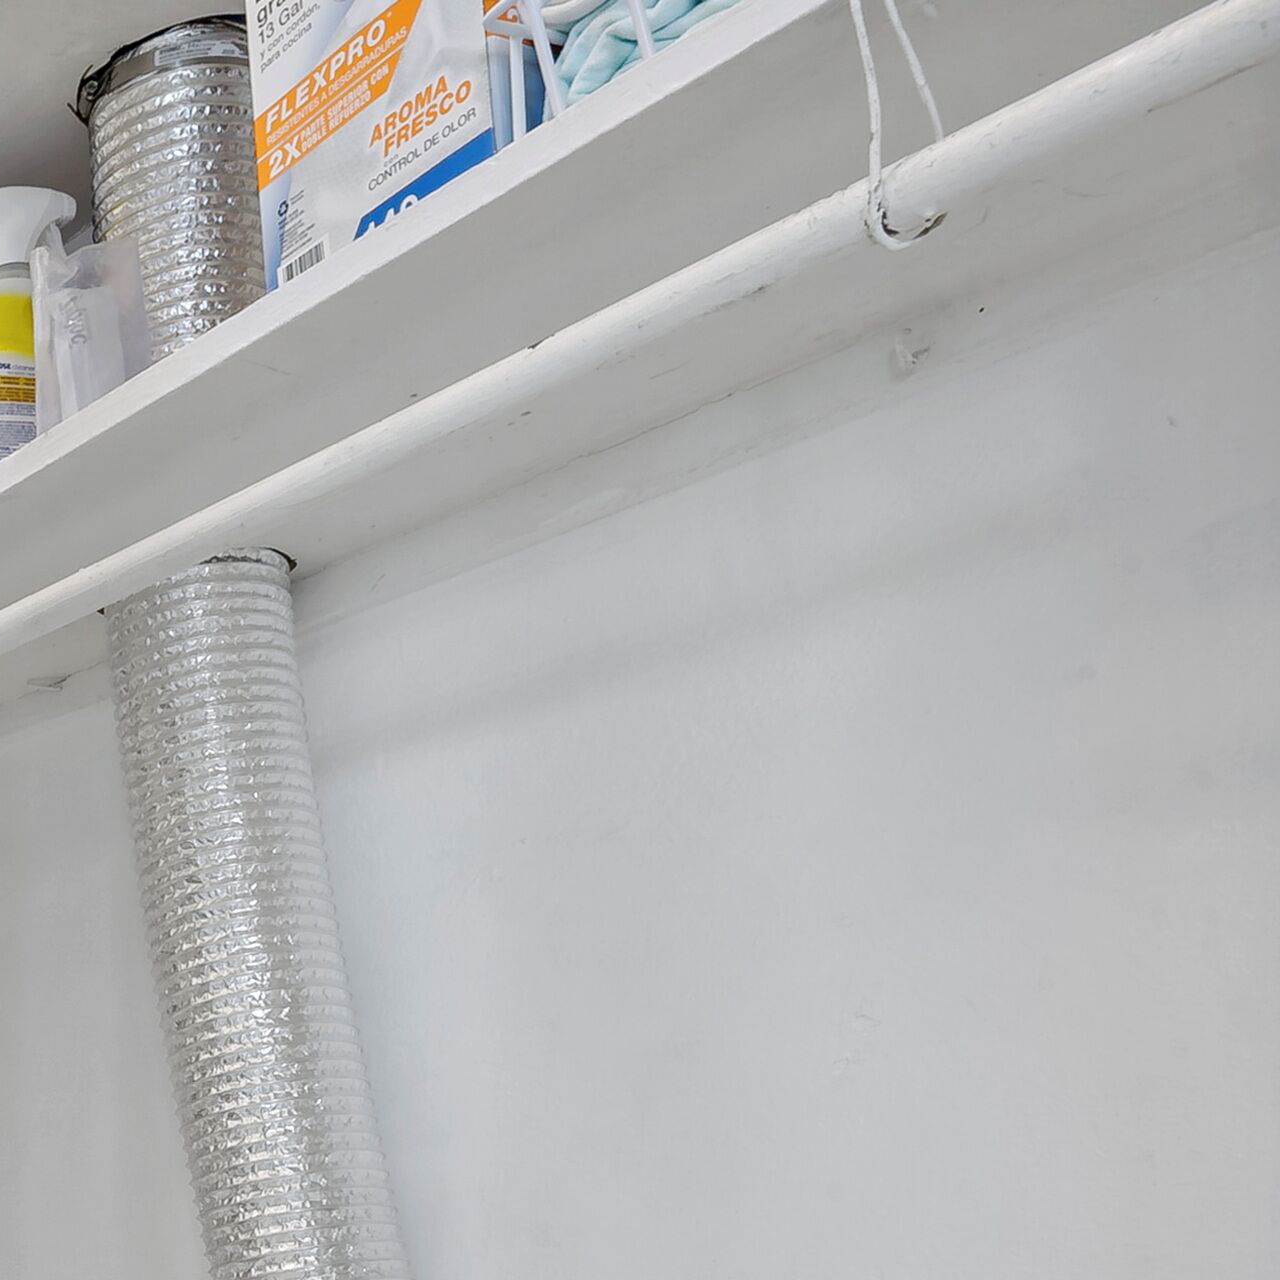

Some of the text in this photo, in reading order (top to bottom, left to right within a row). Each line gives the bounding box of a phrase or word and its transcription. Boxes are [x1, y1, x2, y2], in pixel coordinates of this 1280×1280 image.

[258, 21, 274, 44] 13
[260, 51, 281, 74] para
[282, 22, 312, 52] cocina
[267, 33, 284, 52] con
[266, 19, 386, 134] FLEXPRO
[267, 97, 320, 145] RESISTENTES
[328, 27, 407, 95] DESGARRADURAS
[369, 75, 448, 148] AROMA
[269, 64, 389, 178] 2X PARTE SUPERIOR CON
[302, 91, 371, 151] DOBLE REFUERZO
[368, 107, 477, 191] CONTROL DE OLOR
[384, 80, 472, 158] FRESCO
